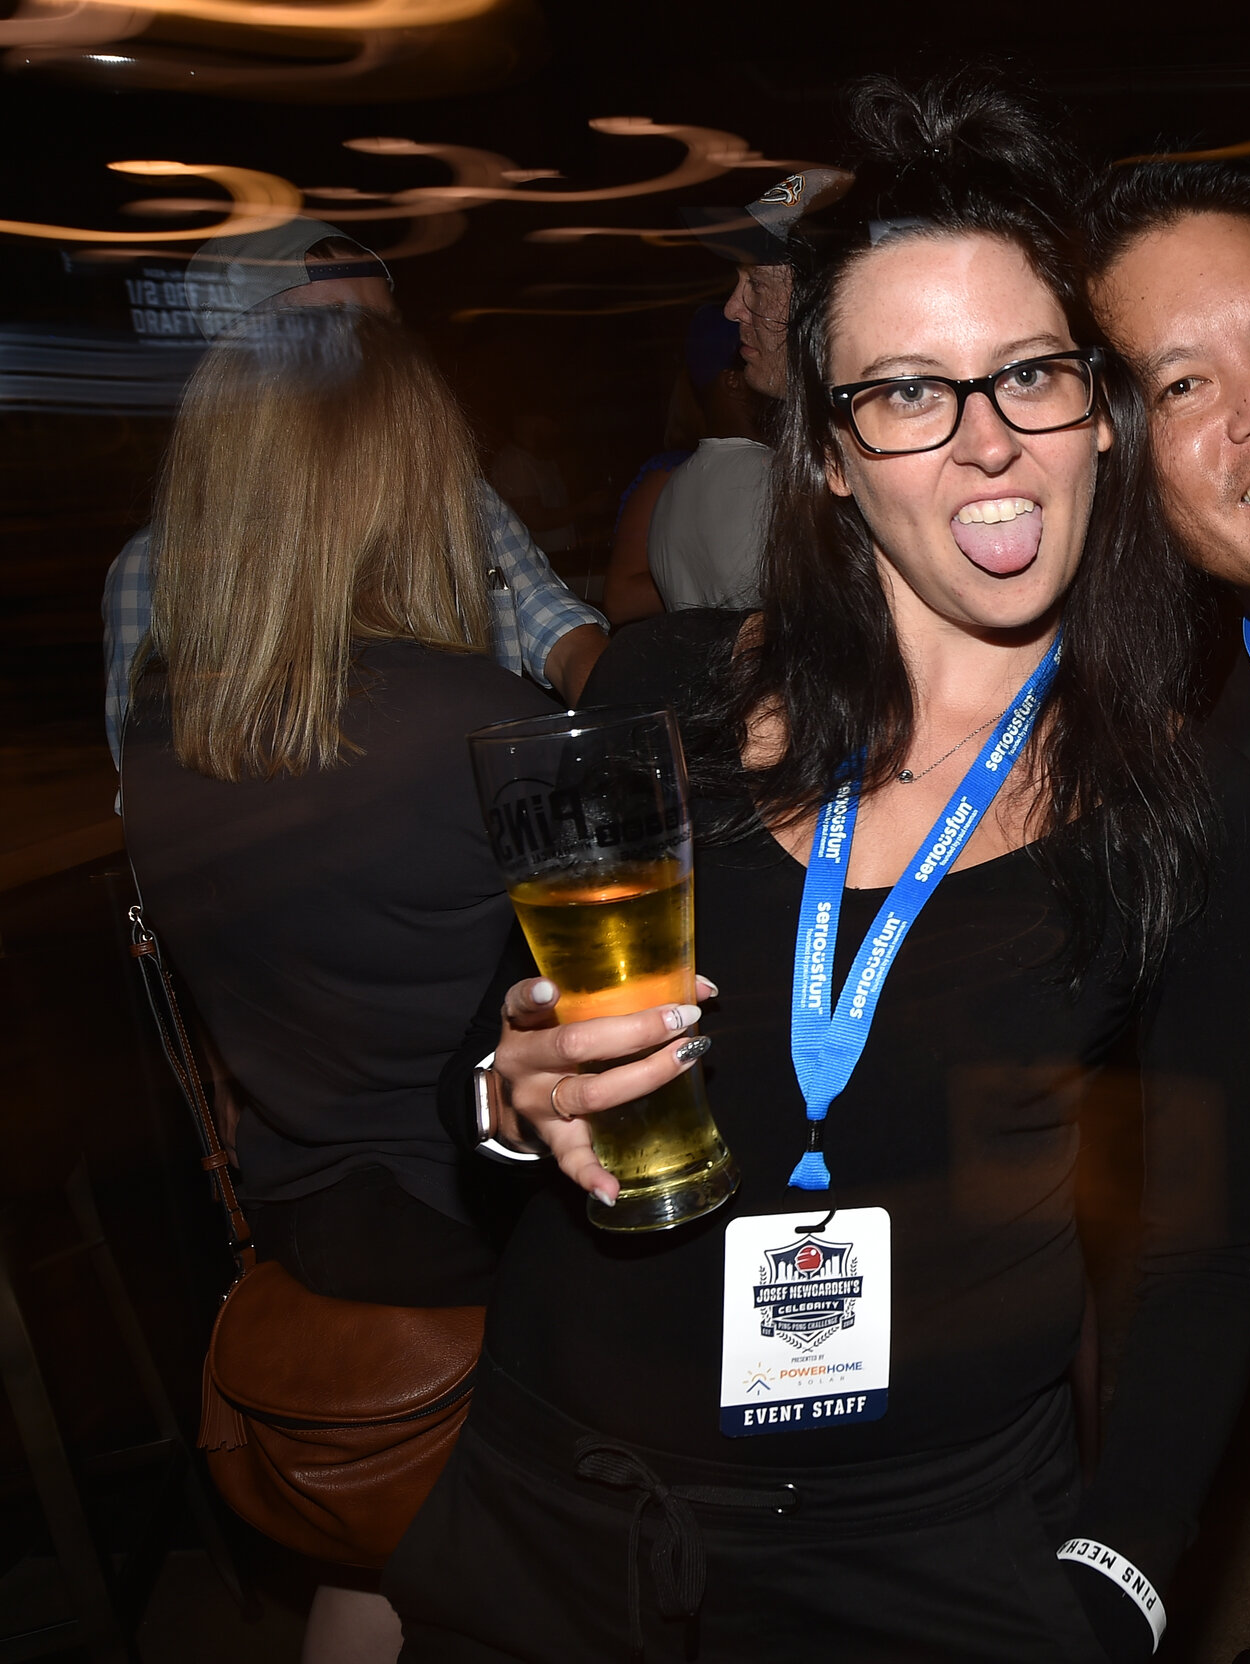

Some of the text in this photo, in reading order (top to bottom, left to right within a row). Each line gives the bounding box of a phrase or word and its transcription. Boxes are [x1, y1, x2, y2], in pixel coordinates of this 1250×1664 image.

[756, 1279, 860, 1303] JOSEF NEWGARDEN'S
[778, 1300, 840, 1315] CELEBRITY
[780, 1361, 863, 1379] POWERHOME
[798, 1375, 845, 1387] SOLAR
[743, 1395, 867, 1426] EVENT STAFF
[1121, 1567, 1157, 1611] PINS
